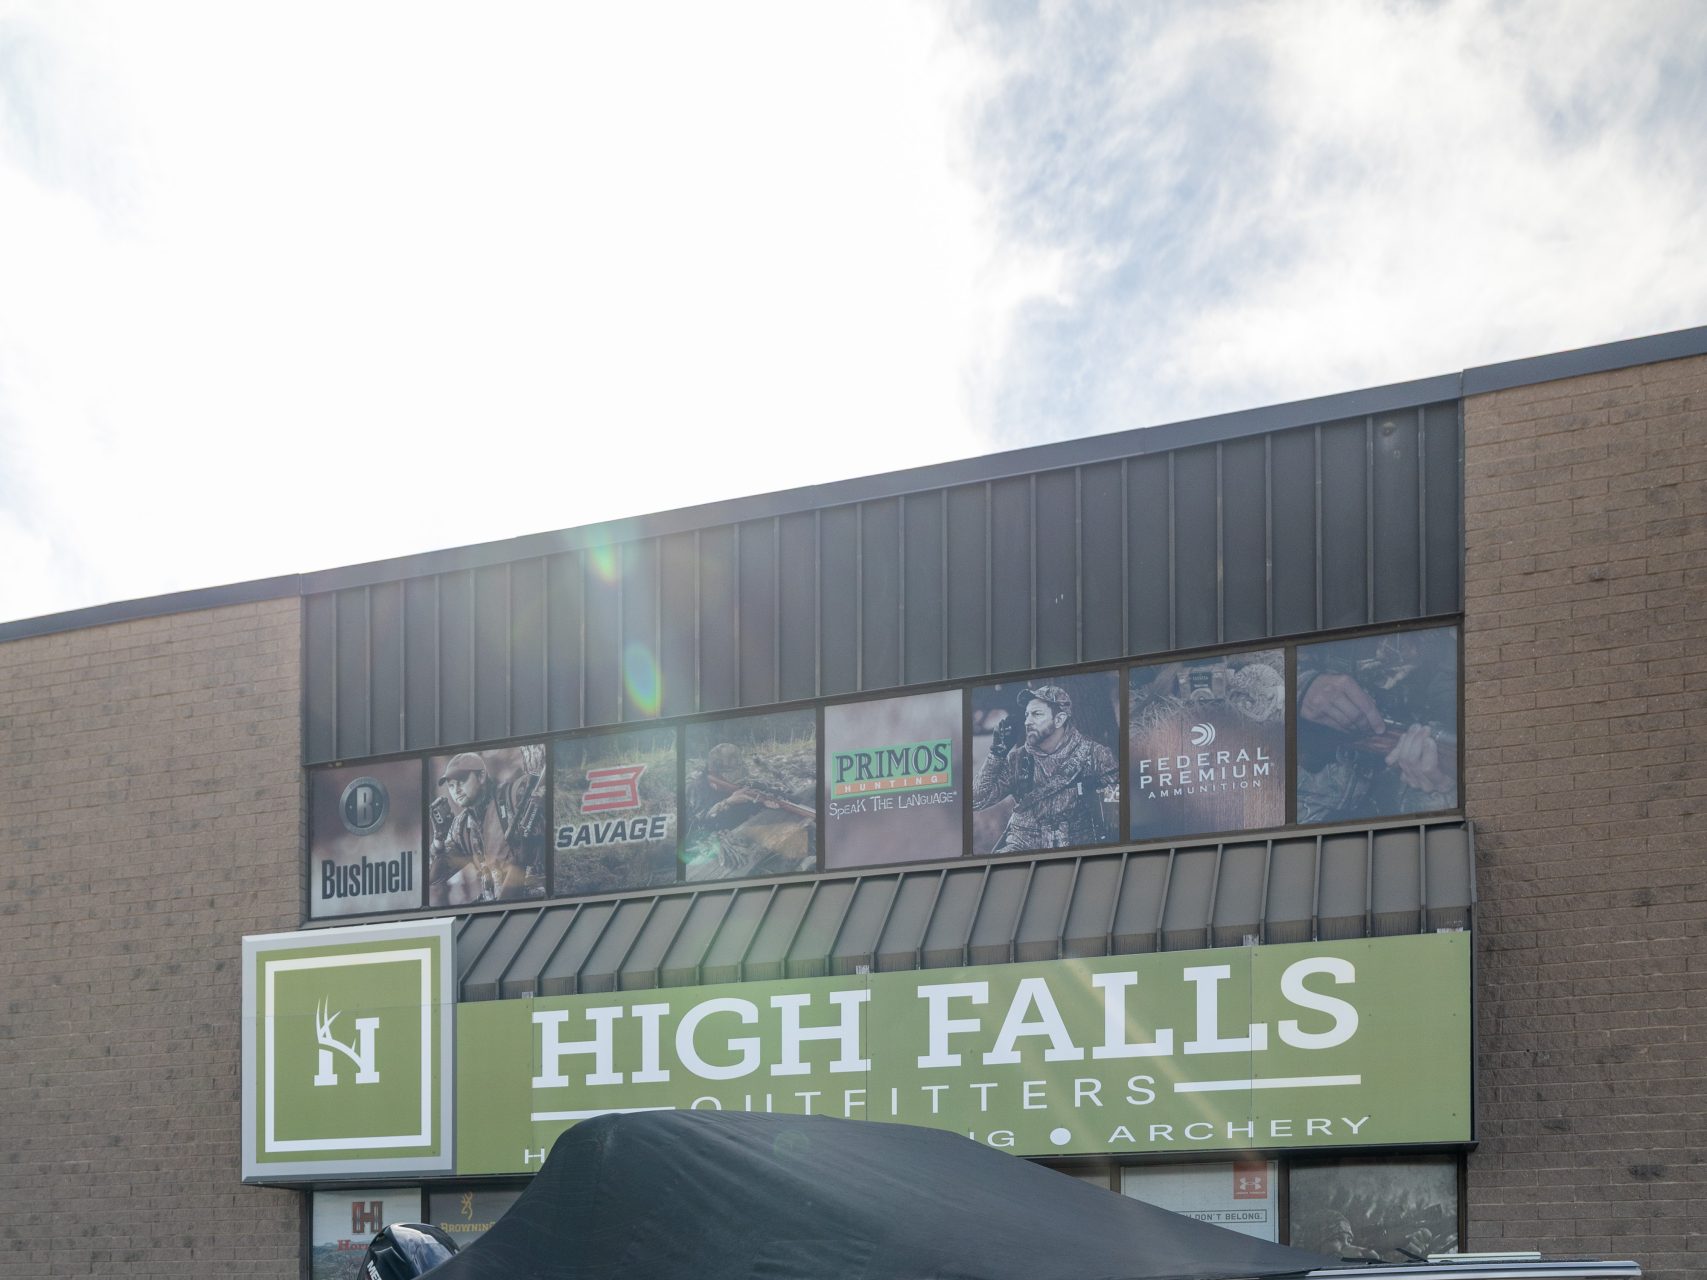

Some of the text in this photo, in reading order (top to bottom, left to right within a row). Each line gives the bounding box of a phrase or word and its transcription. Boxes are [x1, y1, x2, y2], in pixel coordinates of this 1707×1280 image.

[835, 743, 948, 783] PRIMOS
[1140, 747, 1270, 773] FEDERAL
[844, 775, 938, 793] HUNTING
[1140, 763, 1269, 789] PREMIUM
[1148, 780, 1261, 799] AMMUNITION
[356, 786, 374, 827] B
[869, 796, 893, 811] THE
[556, 815, 668, 849] SAVAGE
[321, 851, 413, 900] Bushnell
[531, 957, 1359, 1089] HIGH FALLS
[1108, 1116, 1370, 1144] ARCHERY
